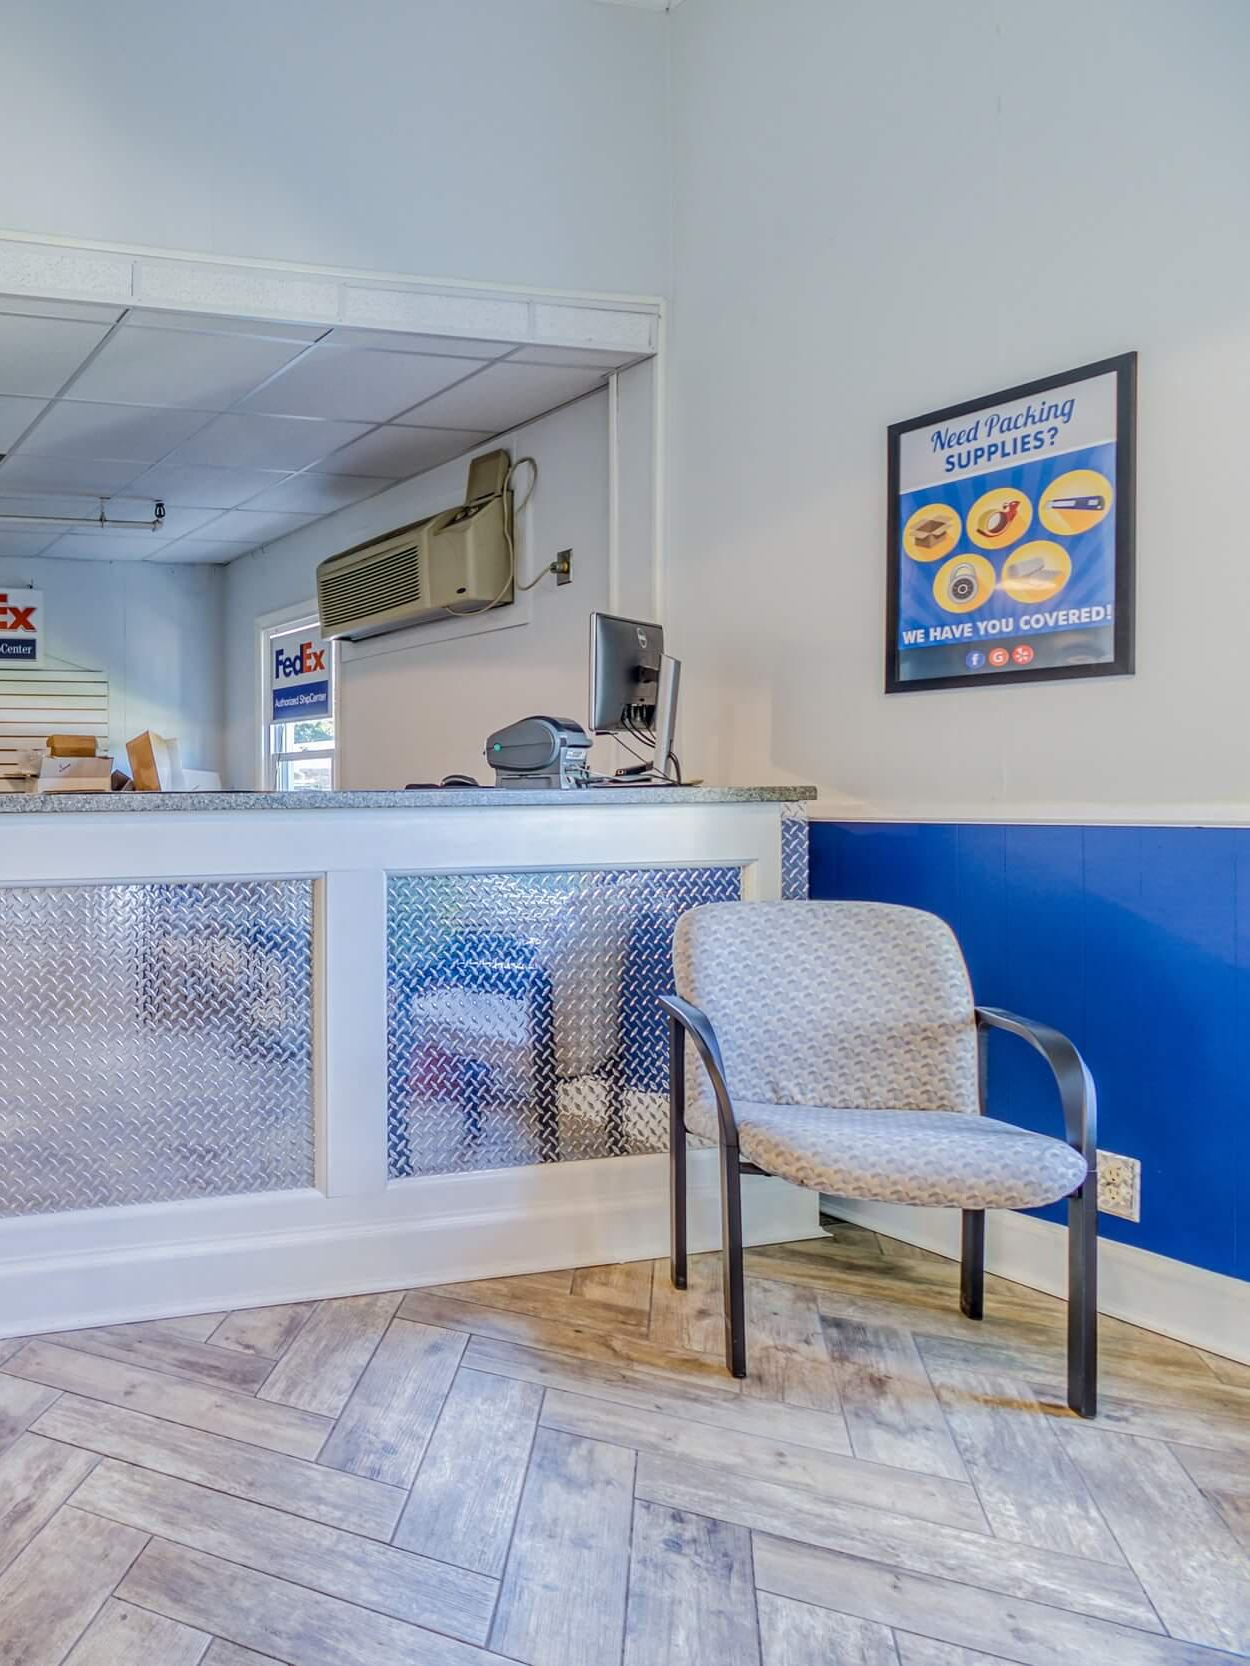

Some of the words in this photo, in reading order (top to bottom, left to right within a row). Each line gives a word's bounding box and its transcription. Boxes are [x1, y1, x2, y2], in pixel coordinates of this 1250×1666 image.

[931, 420, 980, 453] Need
[984, 398, 1076, 438] Packing
[944, 426, 1059, 472] SUPPLIES?
[902, 629, 925, 645] WE
[929, 623, 973, 641] HAVE
[976, 617, 1014, 636] YOU
[1019, 604, 1112, 630] COVERED!
[275, 641, 326, 680] FedEx
